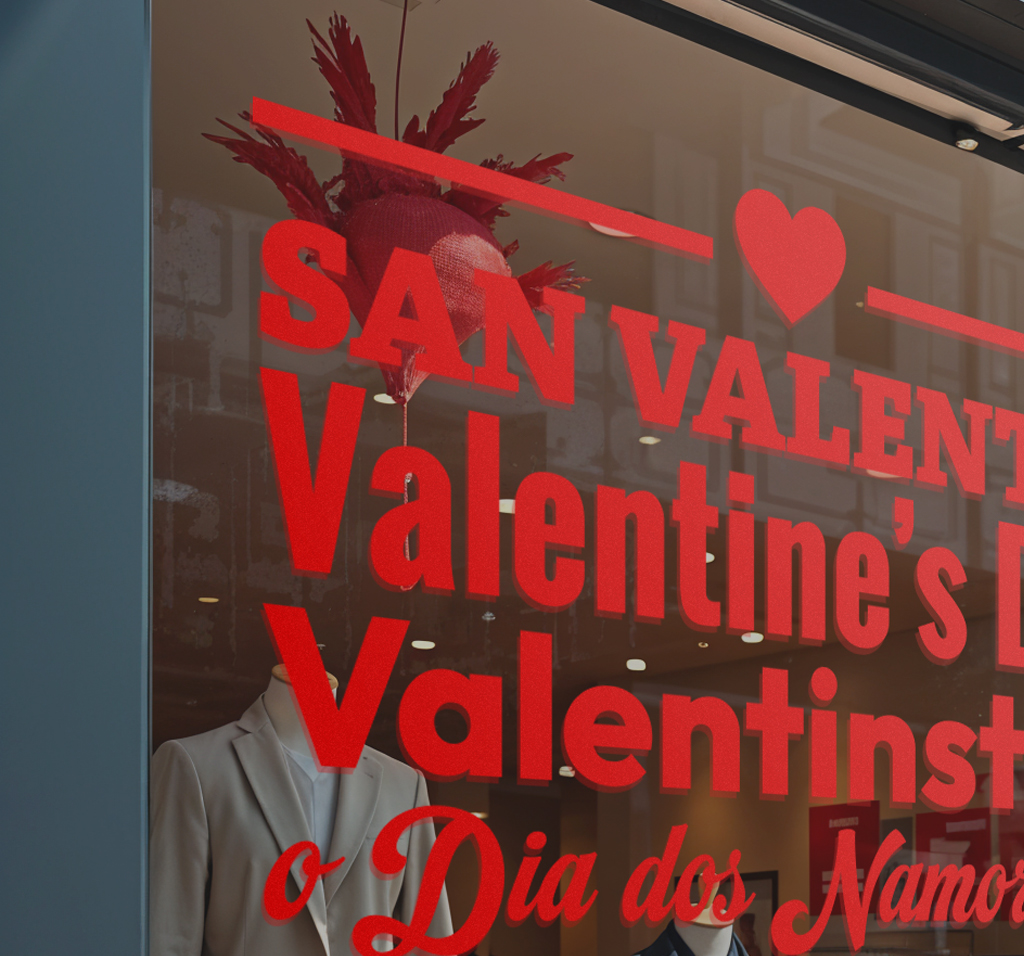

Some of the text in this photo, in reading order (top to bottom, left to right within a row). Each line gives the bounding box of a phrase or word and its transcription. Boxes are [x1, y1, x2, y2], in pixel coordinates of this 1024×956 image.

[259, 218, 586, 405] SAN
[259, 367, 968, 661] Valentine’s
[263, 840, 346, 921] o
[621, 822, 757, 925] dos
